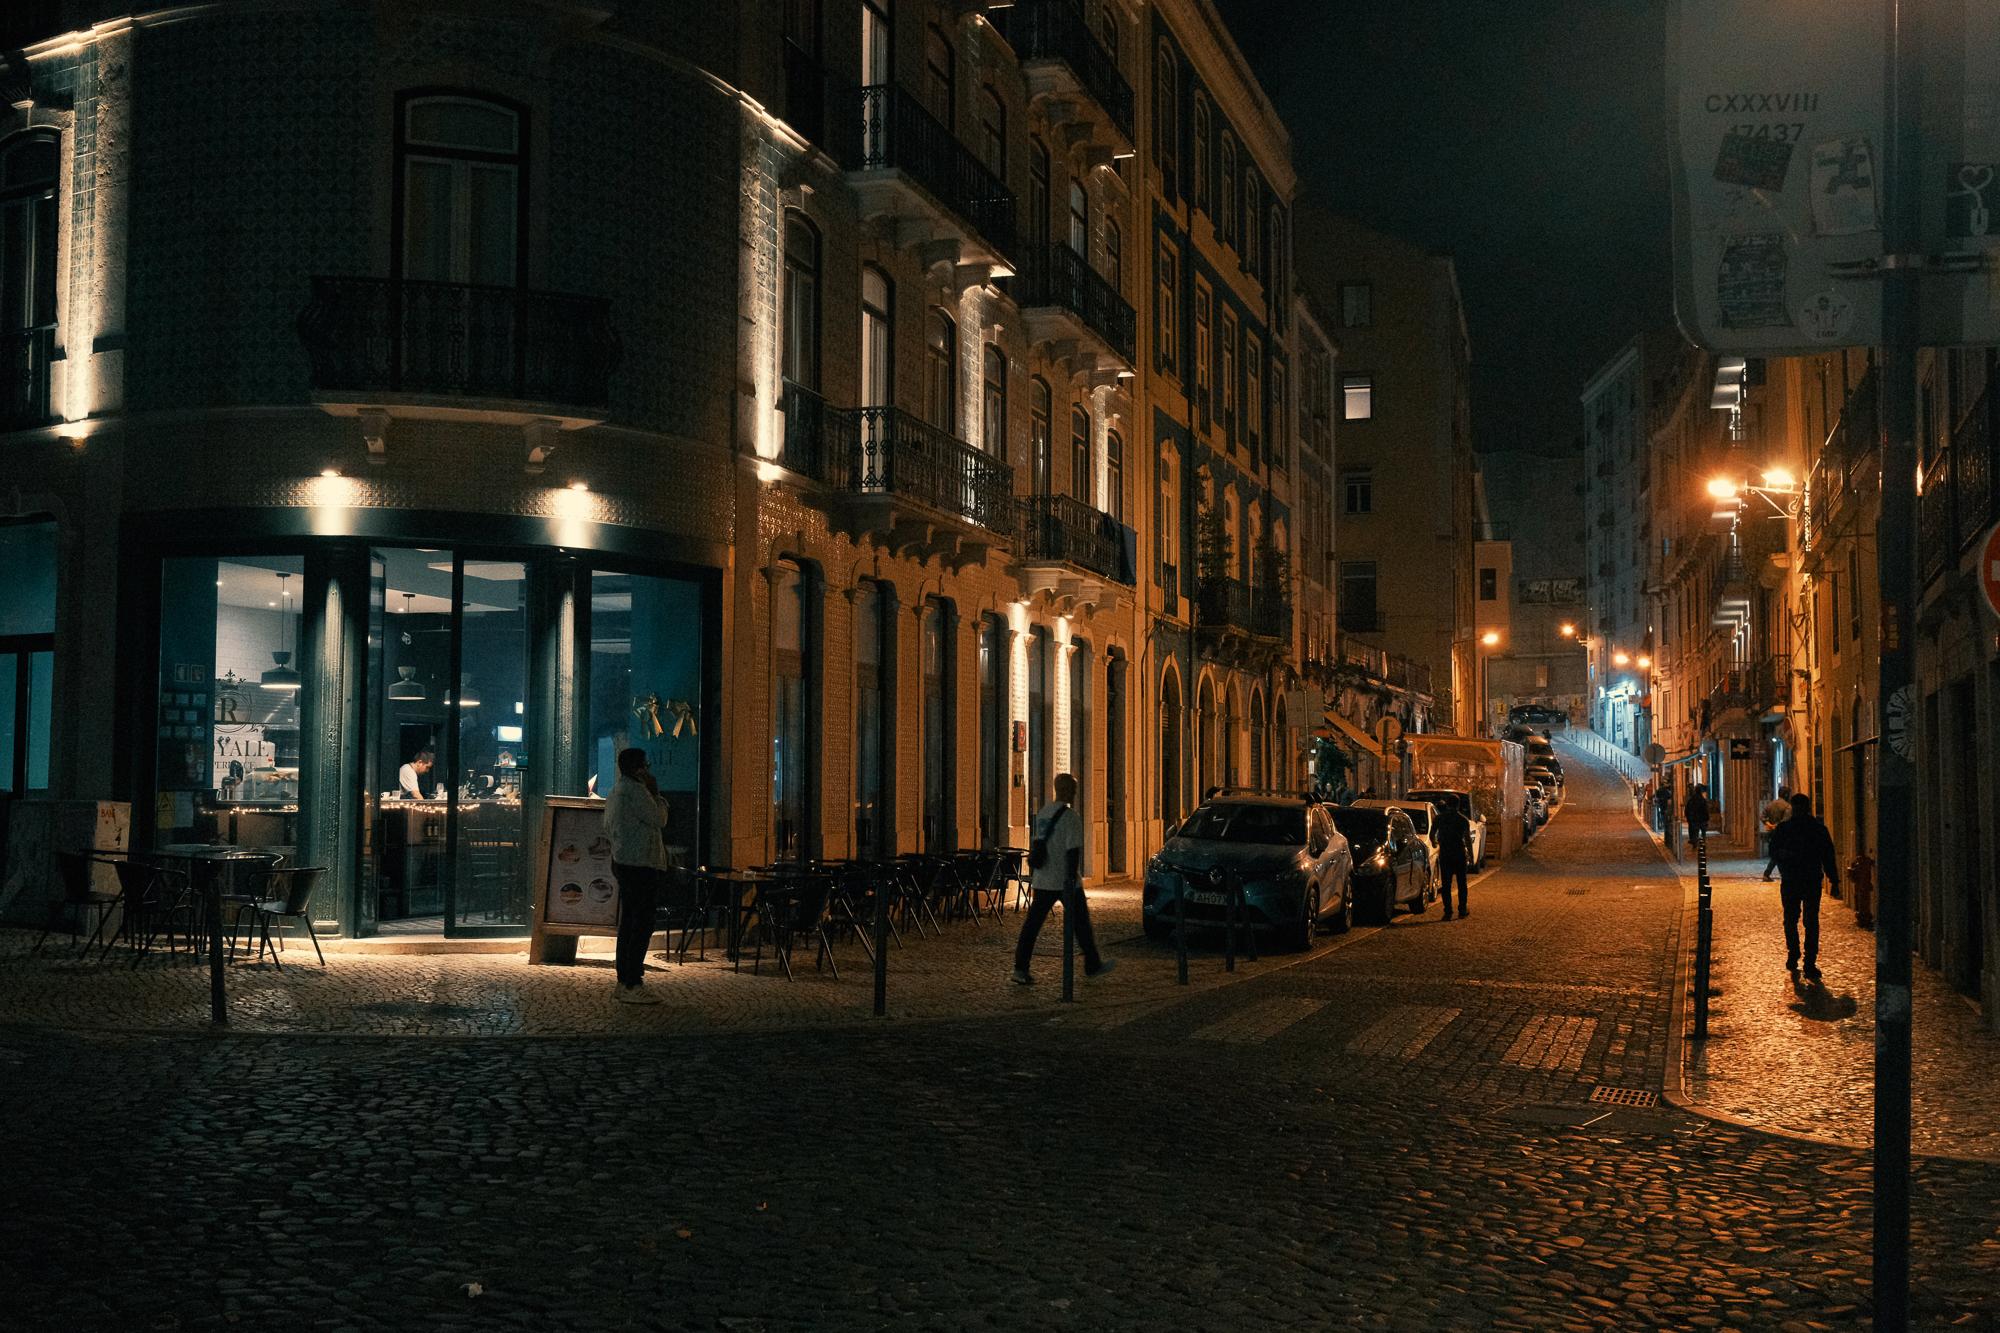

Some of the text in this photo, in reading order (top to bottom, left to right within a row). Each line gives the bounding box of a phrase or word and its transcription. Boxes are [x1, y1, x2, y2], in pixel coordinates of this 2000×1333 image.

[1705, 94, 1817, 113] CXXXVIII
[221, 698, 237, 722] R
[216, 737, 269, 756] YALE
